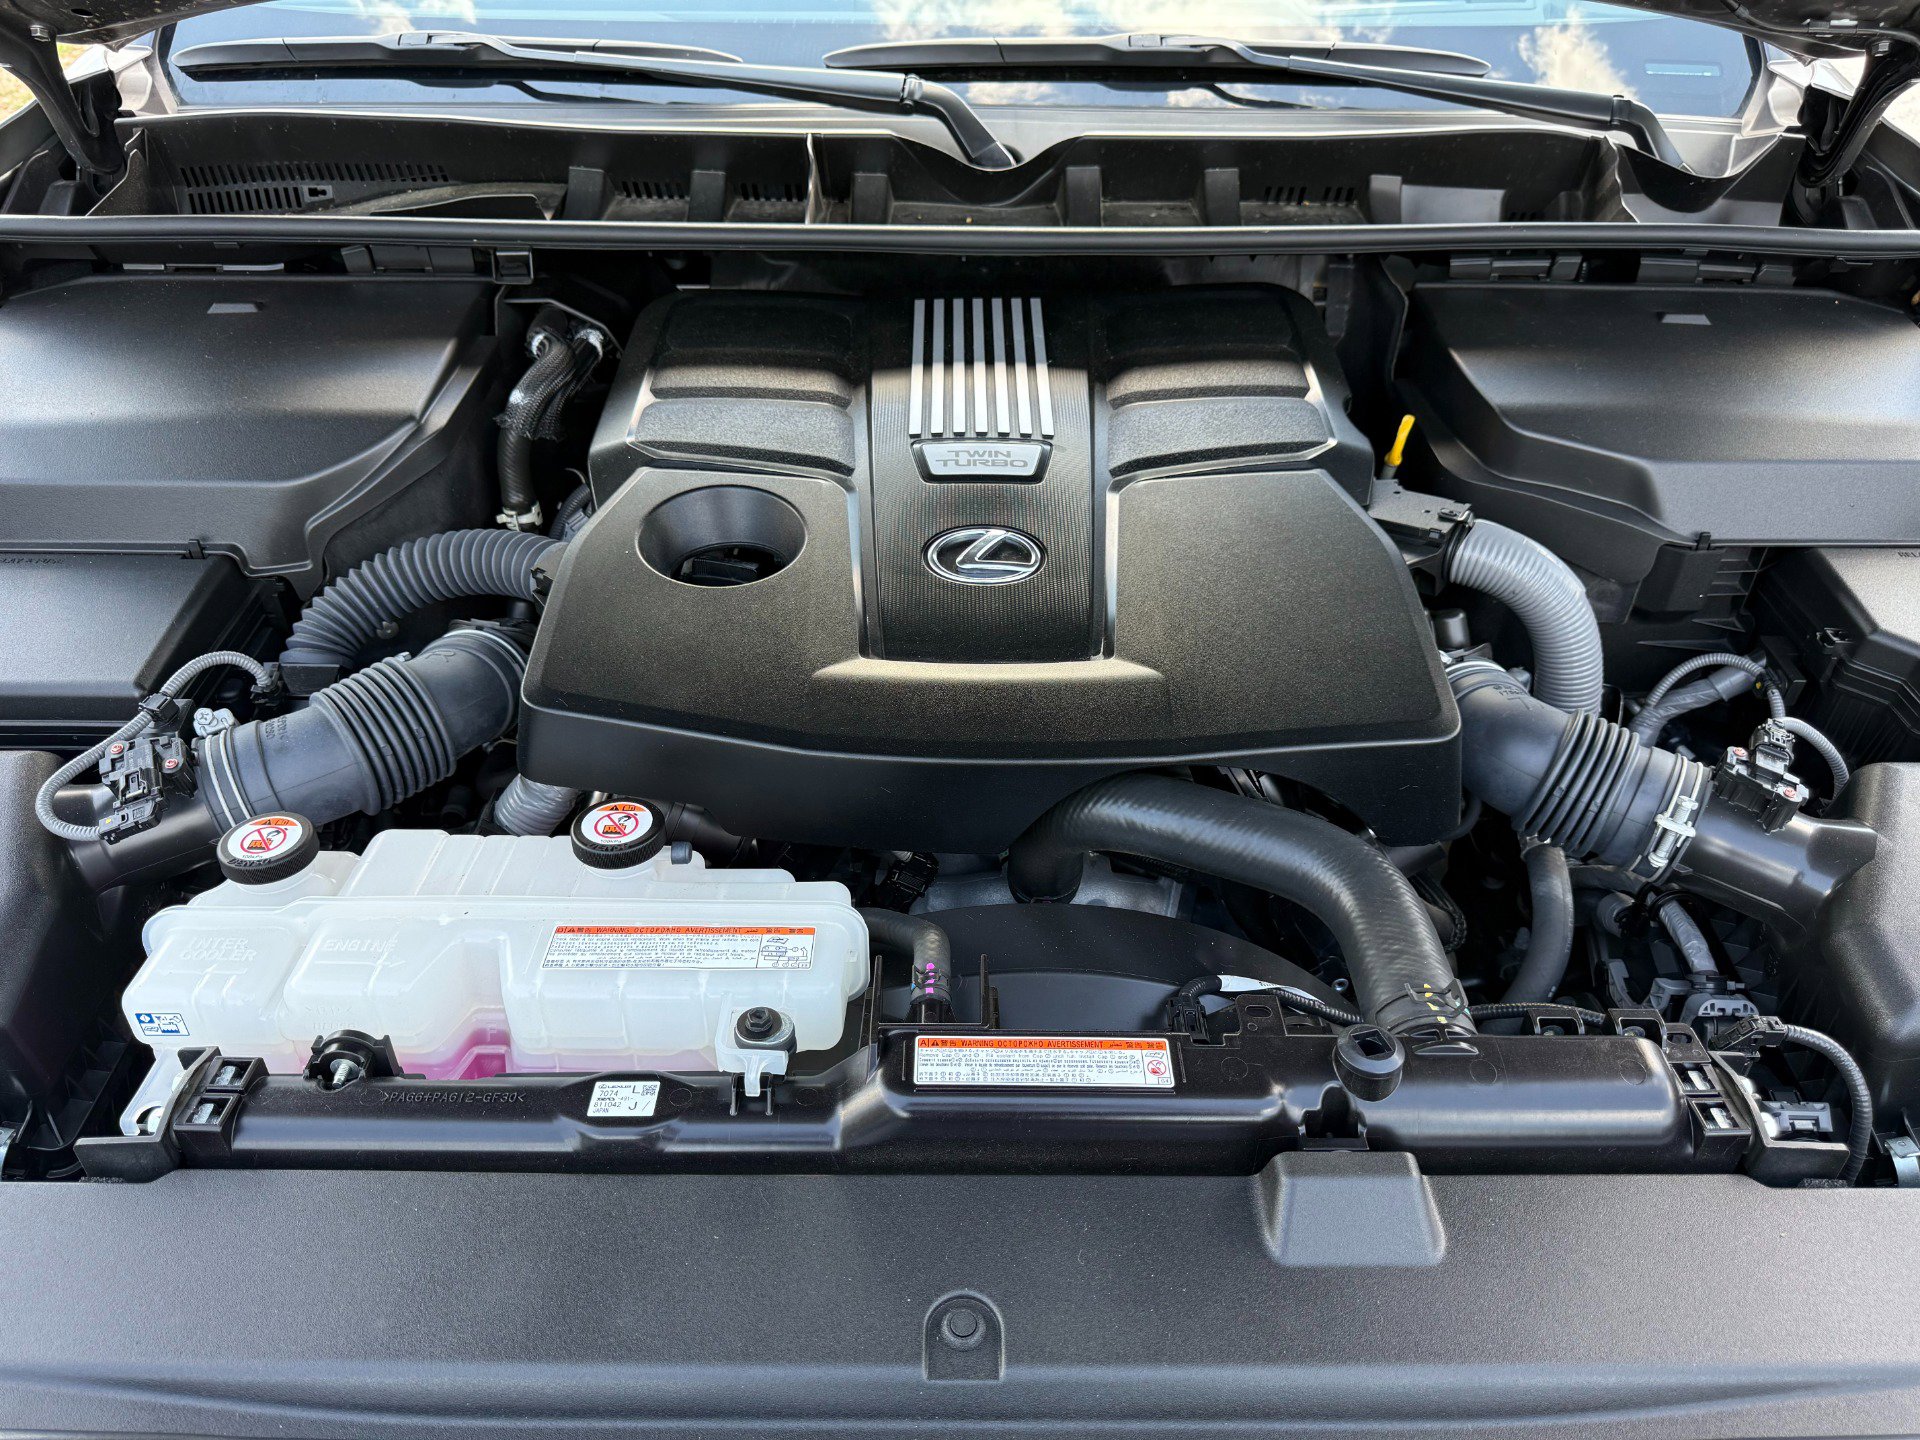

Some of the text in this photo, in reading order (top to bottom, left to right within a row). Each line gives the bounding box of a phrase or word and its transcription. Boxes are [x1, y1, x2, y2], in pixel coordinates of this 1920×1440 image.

[946, 450, 1012, 459] TWIN
[935, 459, 1029, 468] TURBO
[189, 937, 249, 949] INTER
[324, 938, 399, 951] ENGINE
[179, 950, 257, 962] COOLER
[997, 1040, 1044, 1048] ОСТОРОЖНО
[1047, 1040, 1104, 1048] AVERTISSEMENT
[631, 1085, 641, 1094] L
[628, 1101, 638, 1111] J
